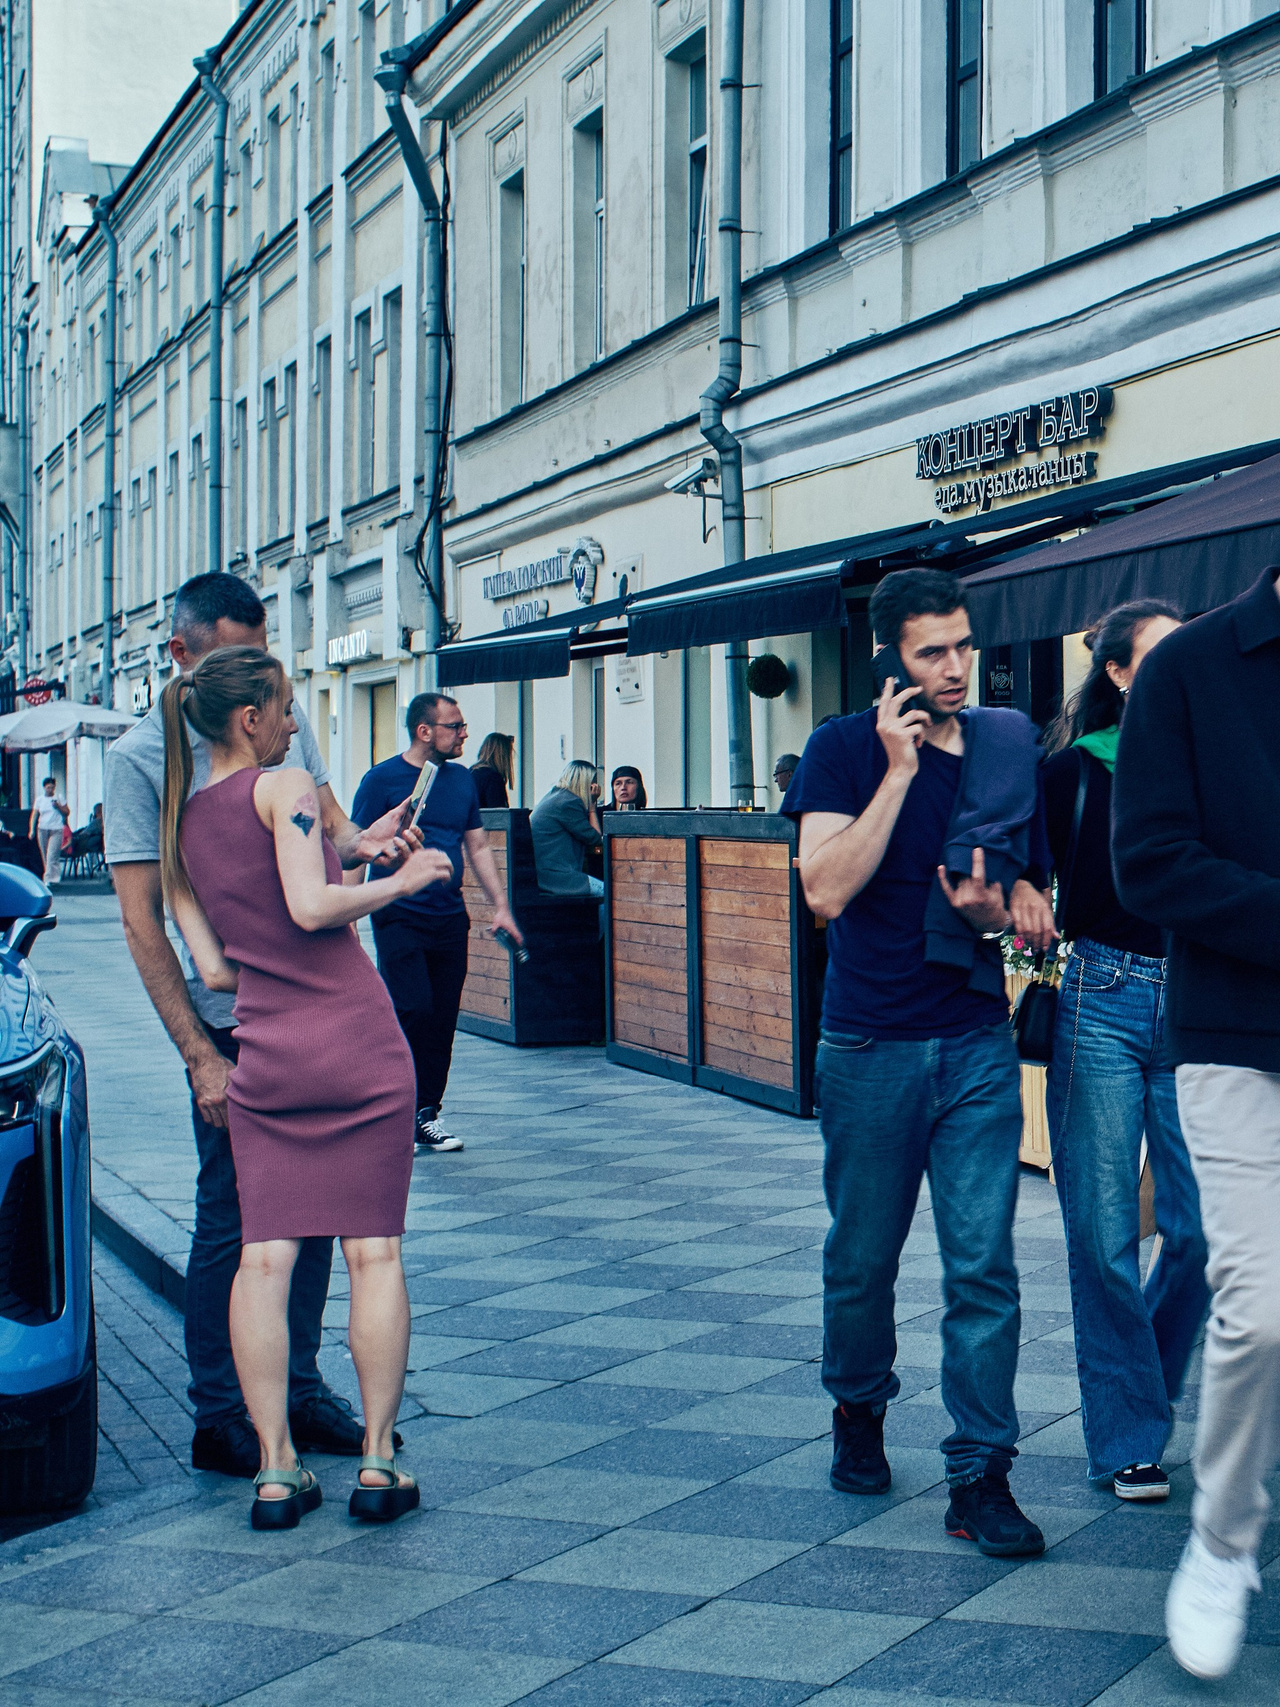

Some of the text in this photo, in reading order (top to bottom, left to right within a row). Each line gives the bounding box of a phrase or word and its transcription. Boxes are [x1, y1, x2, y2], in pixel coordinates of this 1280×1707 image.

[915, 386, 1100, 480] КОНЦЕРТ БАР
[328, 629, 367, 665] INCANTO
